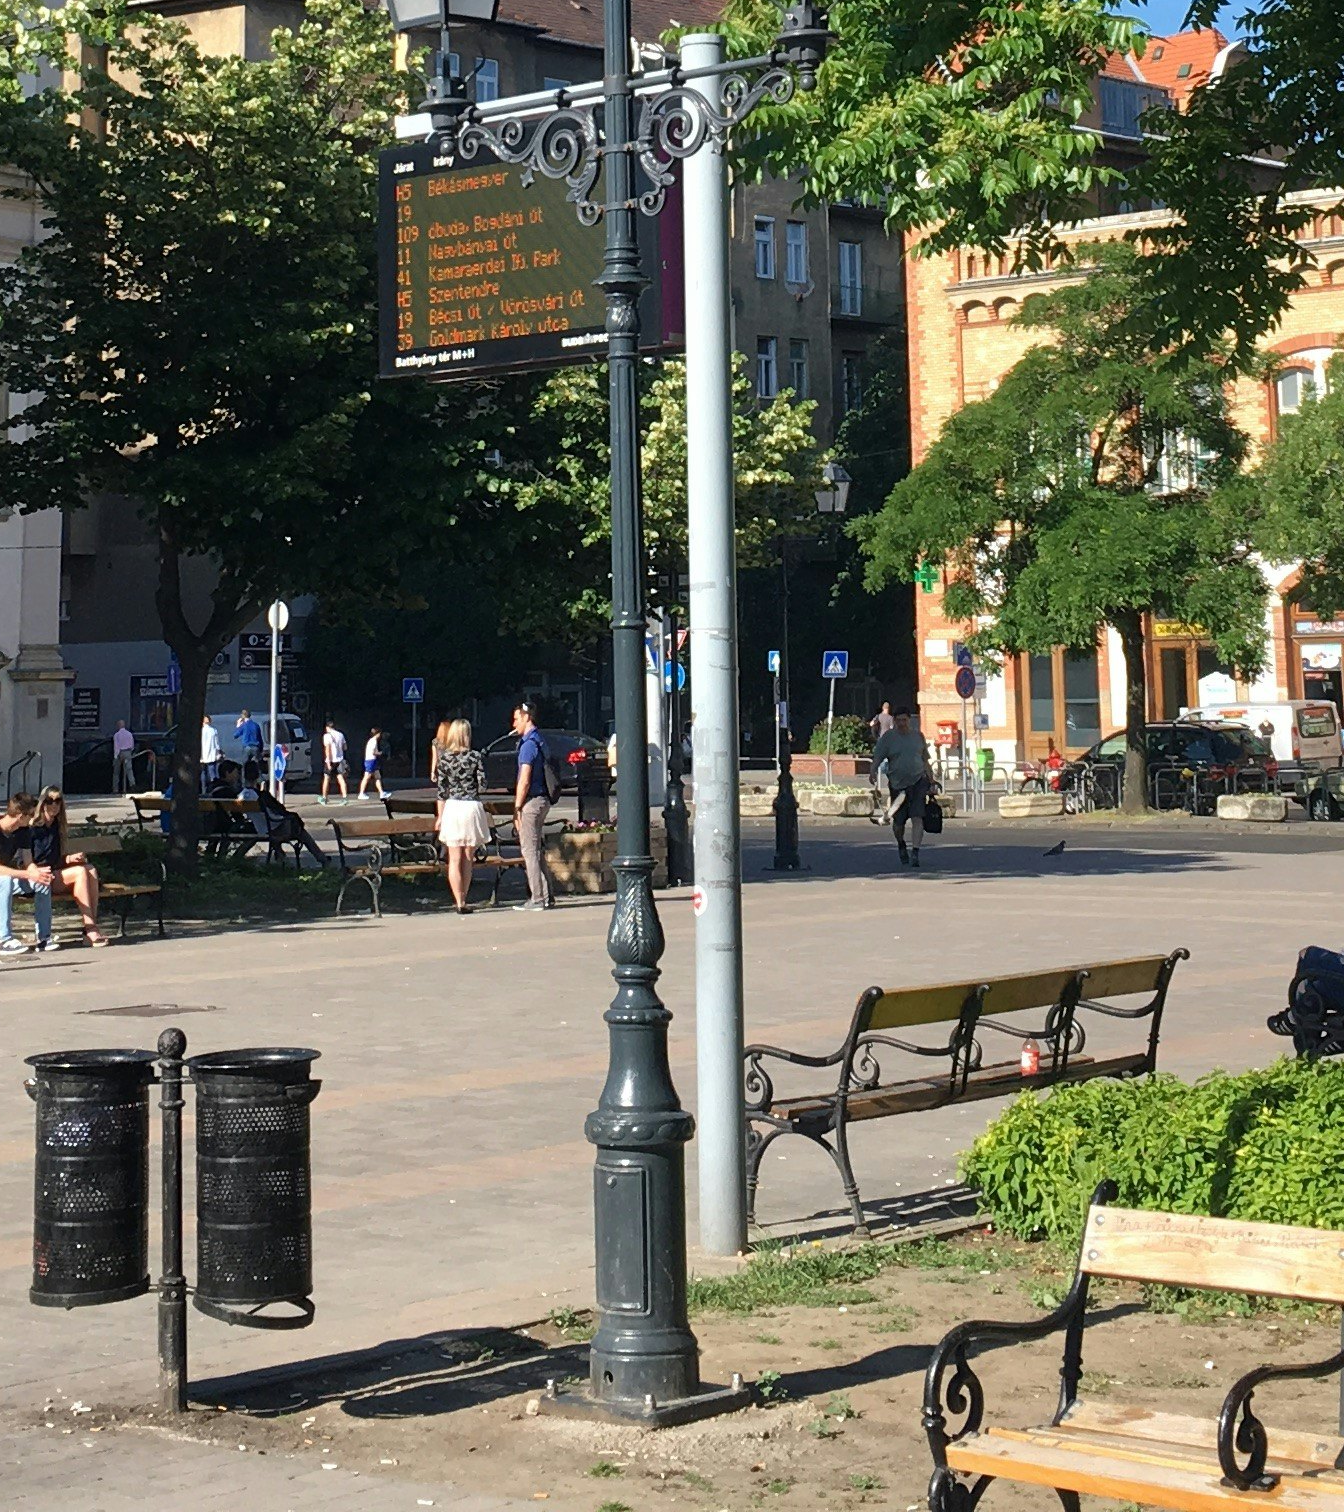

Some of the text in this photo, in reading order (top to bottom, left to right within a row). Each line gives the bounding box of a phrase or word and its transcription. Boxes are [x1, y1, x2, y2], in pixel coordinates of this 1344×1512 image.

[397, 205, 412, 223] 19
[397, 225, 419, 244] 109
[397, 248, 410, 266] 11
[397, 269, 411, 286] 41
[532, 248, 562, 268] Park
[428, 280, 500, 304] Szentendre
[398, 311, 414, 330] 19
[397, 333, 414, 351] 39
[537, 315, 570, 334] utca
[395, 353, 437, 368] Batthyány
[438, 350, 452, 363] tér
